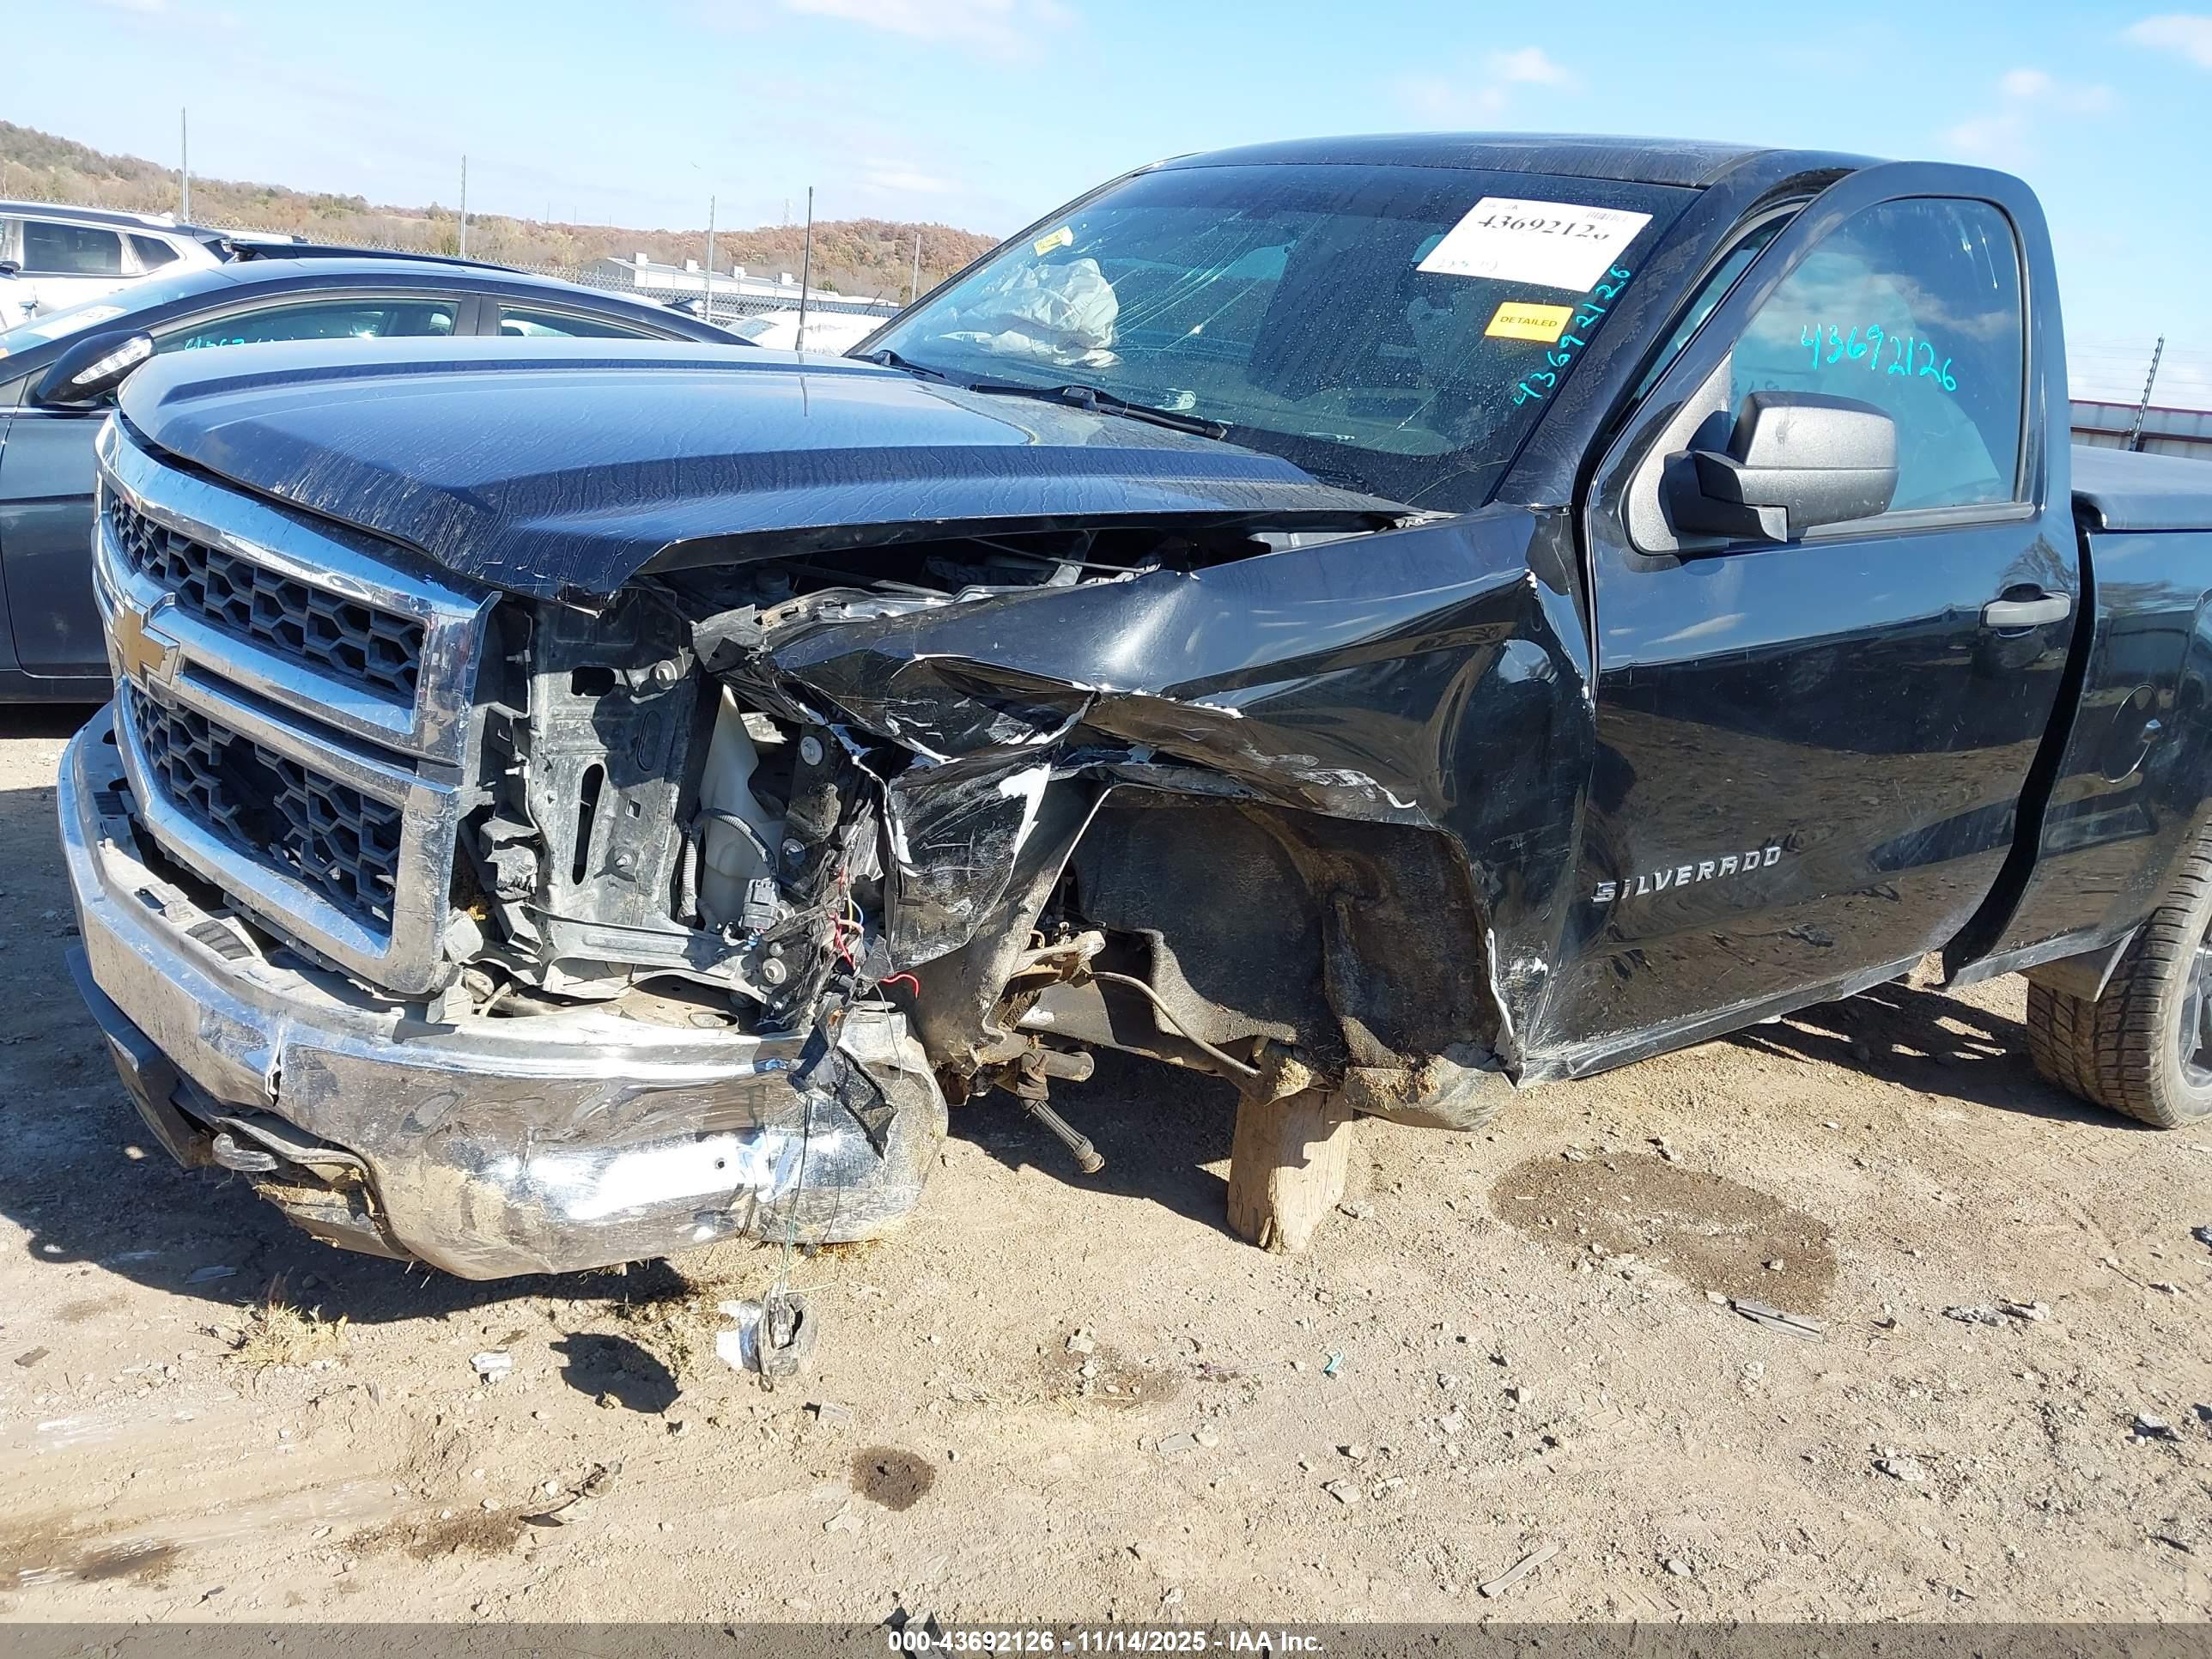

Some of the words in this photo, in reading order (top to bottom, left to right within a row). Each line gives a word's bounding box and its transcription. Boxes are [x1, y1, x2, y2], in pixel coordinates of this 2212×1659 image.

[1499, 316, 1558, 327] DETAILED
[1514, 264, 1631, 405] 43692126
[1801, 323, 1957, 392] 43692126
[1590, 846, 1782, 902] SILVERADO
